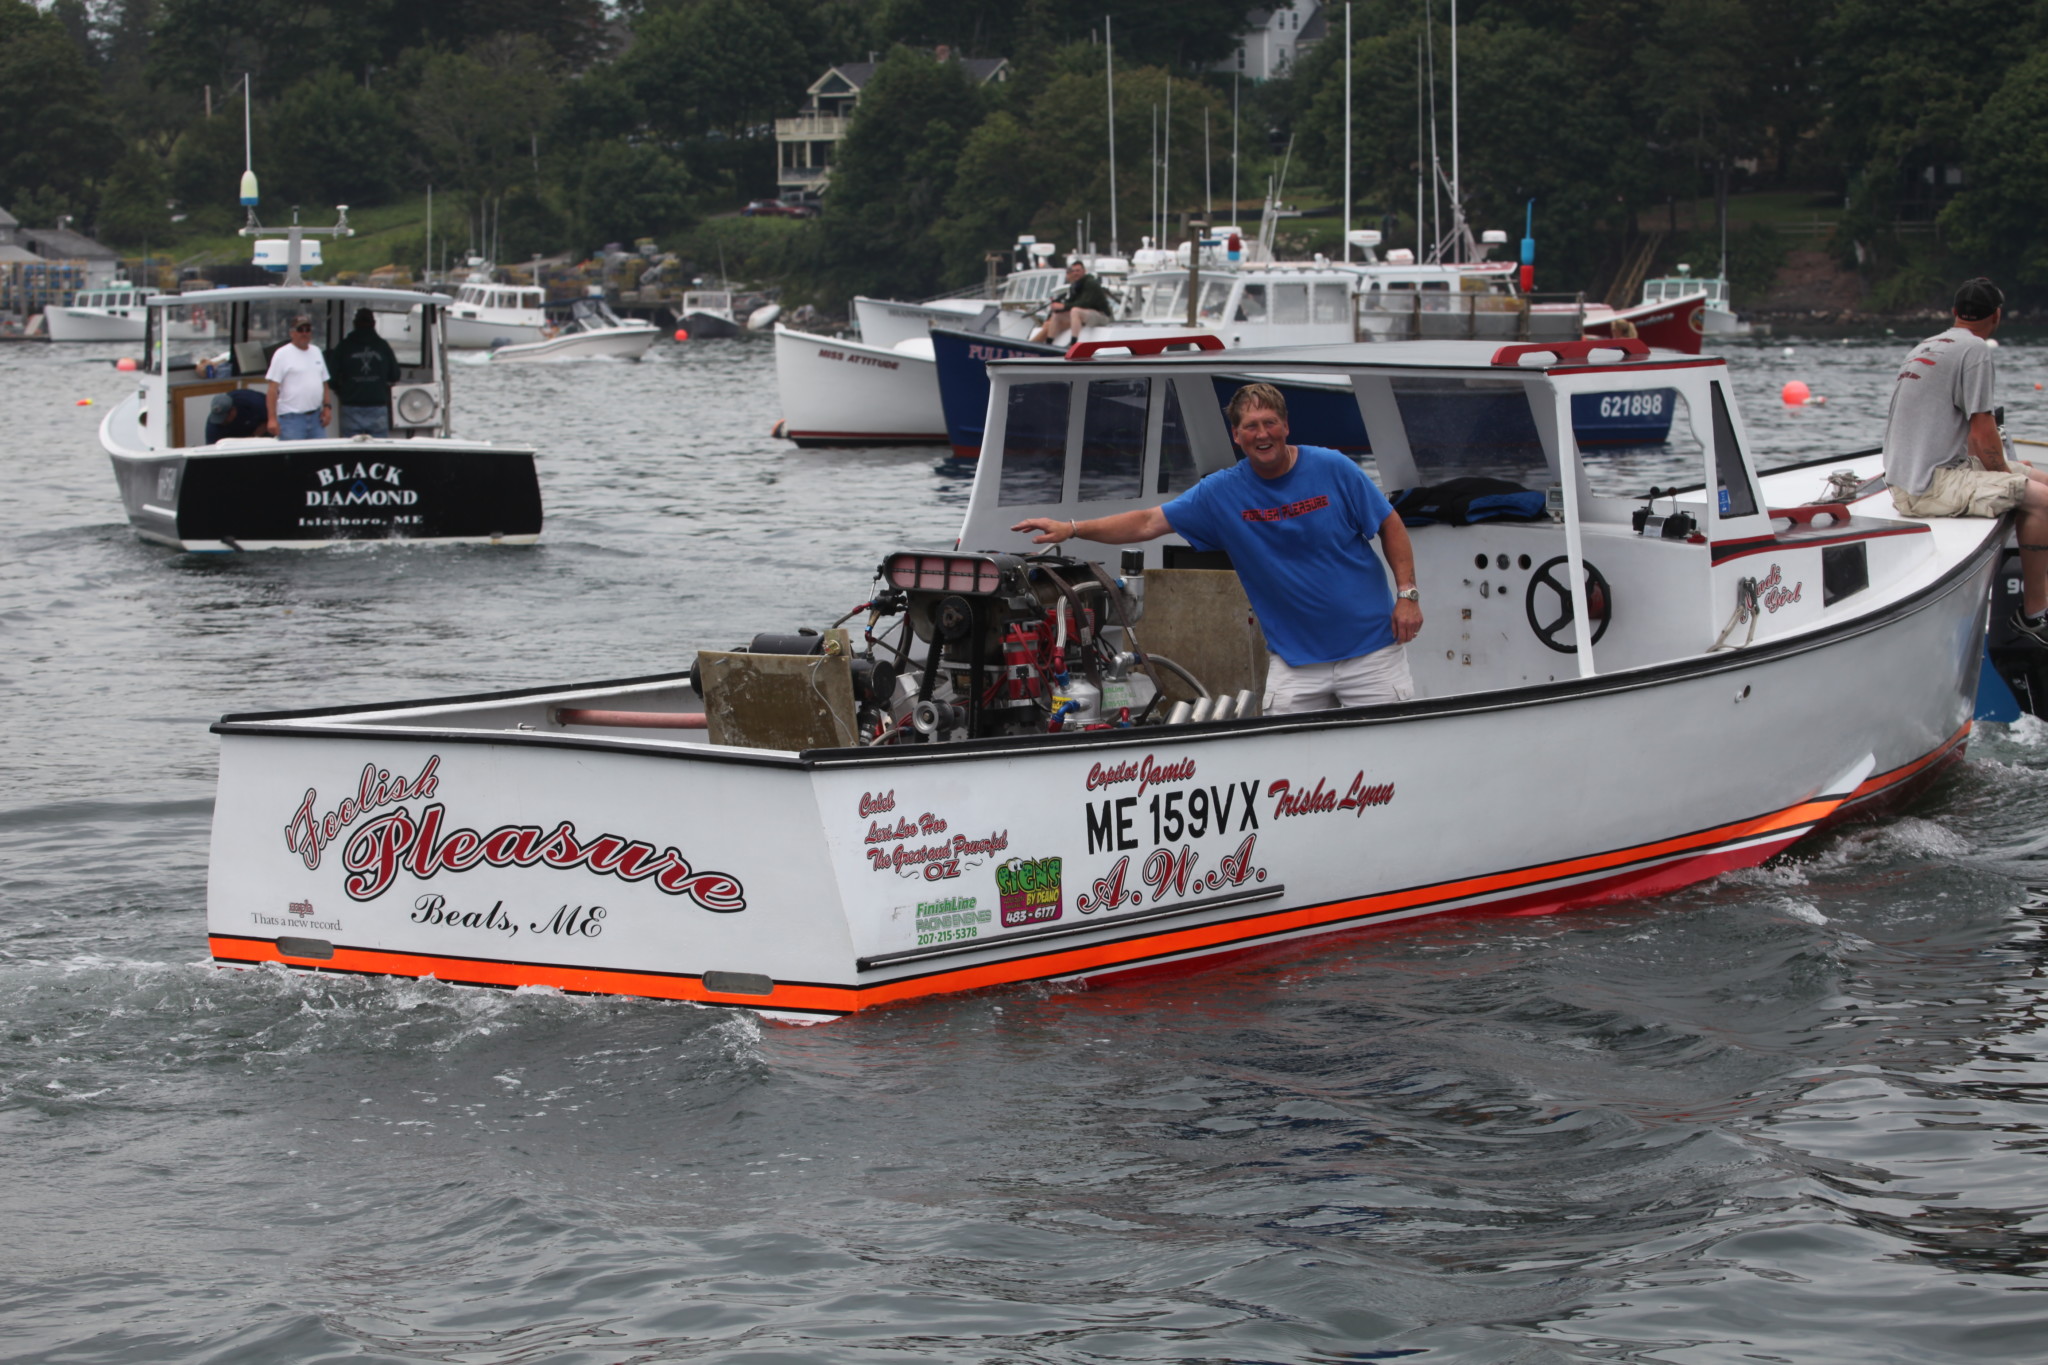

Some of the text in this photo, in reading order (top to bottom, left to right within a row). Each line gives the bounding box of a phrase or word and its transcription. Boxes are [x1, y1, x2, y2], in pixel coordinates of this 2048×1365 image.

[818, 349, 900, 371] MISS ATTITUDE
[1600, 393, 1662, 418] 621898
[316, 461, 403, 487] BLACK
[305, 489, 418, 506] DIAMOND
[1281, 495, 1330, 520] PLEASURE
[298, 515, 424, 527] Islesboro, ME
[1764, 581, 1802, 613] Girl
[2006, 578, 2024, 594] 9
[1086, 754, 1196, 797] Copilot Jamie
[858, 788, 896, 818] Caleb
[1268, 769, 1395, 820] Trisha Lynn
[285, 754, 440, 870] Foolish
[892, 816, 918, 840] Loo
[918, 812, 948, 836] Hoo
[1086, 780, 1260, 855] ME 159VX
[342, 803, 747, 914] Pleasure
[867, 829, 1008, 874] The Great and Powerful
[923, 858, 961, 882] OZ
[995, 856, 1062, 896] SIGNS
[1077, 833, 1267, 914] A.W.A.
[1026, 892, 1036, 906] BY
[1036, 889, 1059, 904] DEANO
[251, 912, 279, 926] Thats
[288, 918, 308, 928] new
[310, 919, 343, 931] record.
[410, 893, 608, 939] Beals, ME
[916, 909, 992, 933] RACING ENGINES
